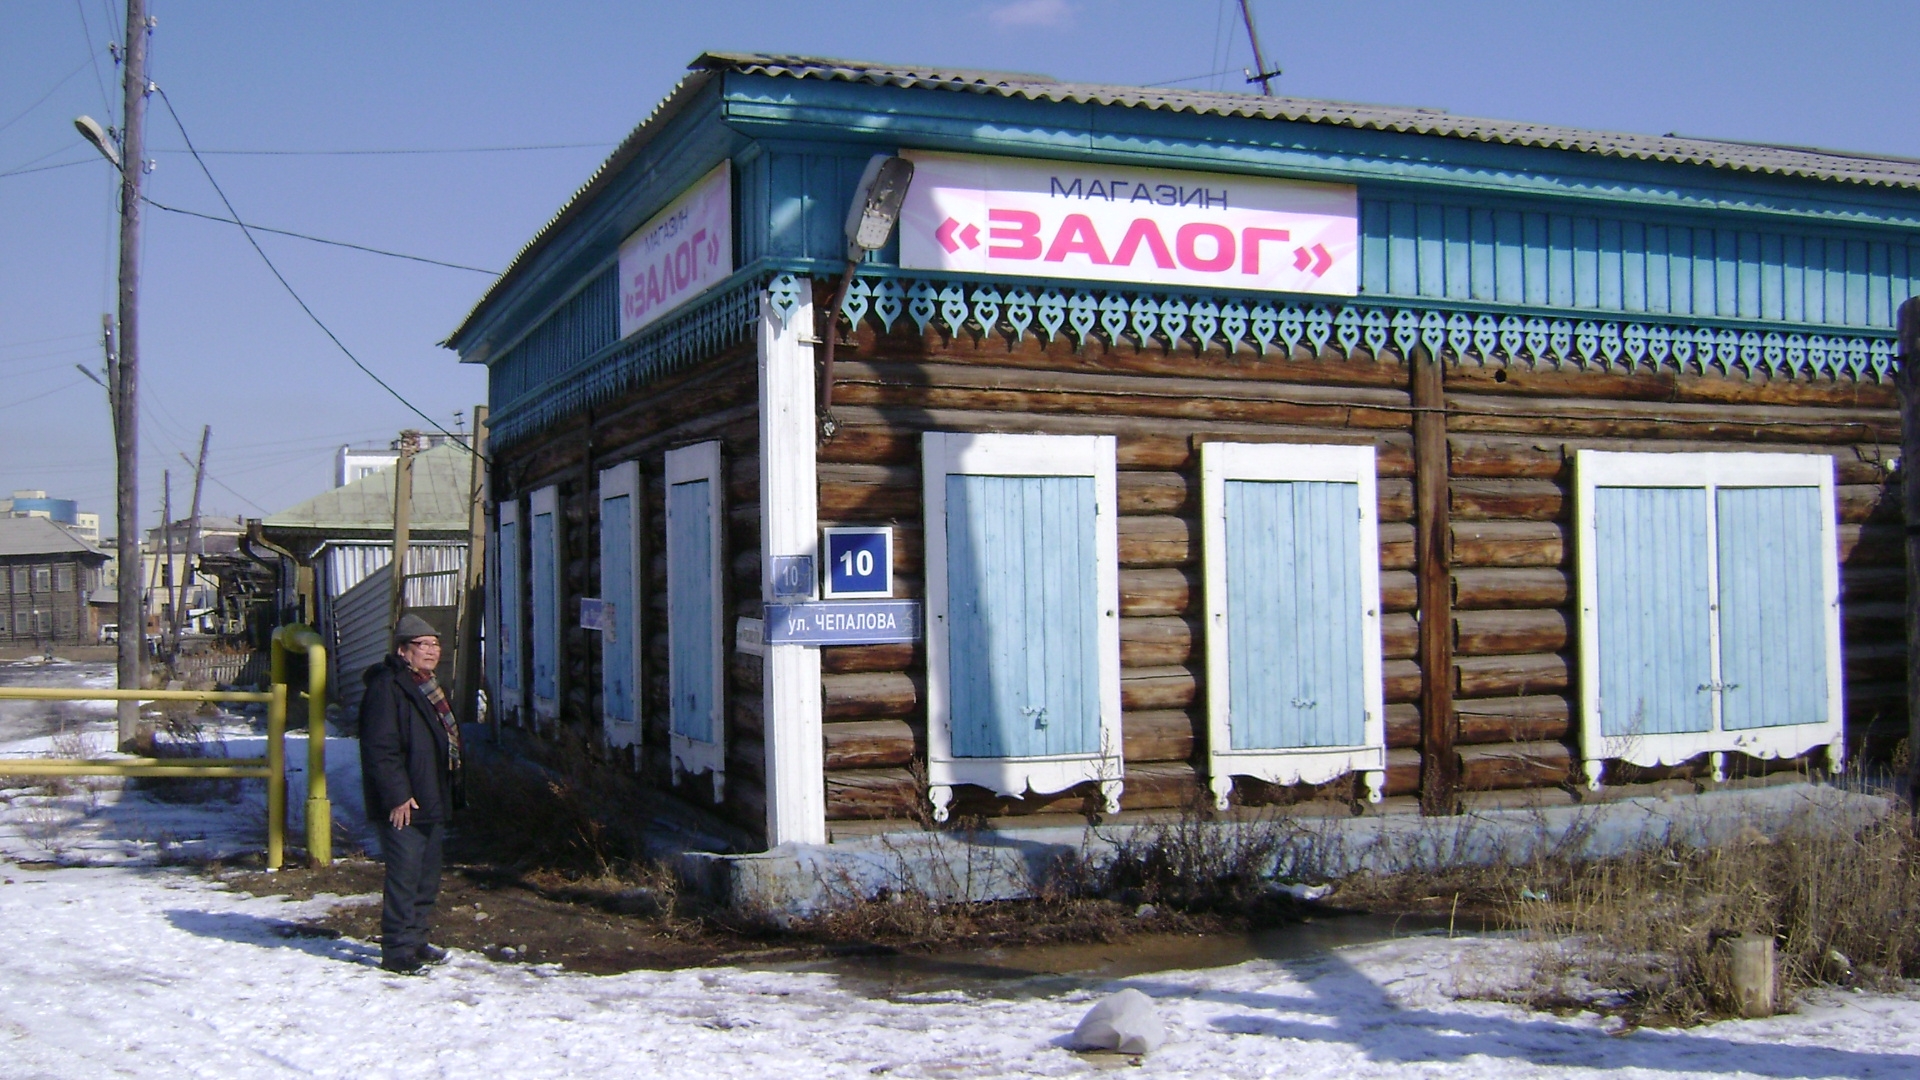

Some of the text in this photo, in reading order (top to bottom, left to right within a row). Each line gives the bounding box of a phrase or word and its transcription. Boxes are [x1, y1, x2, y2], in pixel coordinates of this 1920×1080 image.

[1050, 176, 1229, 211] МАГАЗИН
[934, 208, 1333, 279] «ЗАЛОГ»
[624, 228, 720, 321] «ЗАЛОГ»
[782, 565, 799, 587] 10
[839, 549, 875, 577] 10
[788, 612, 897, 636] ул. ЧЕПАЛОВА
